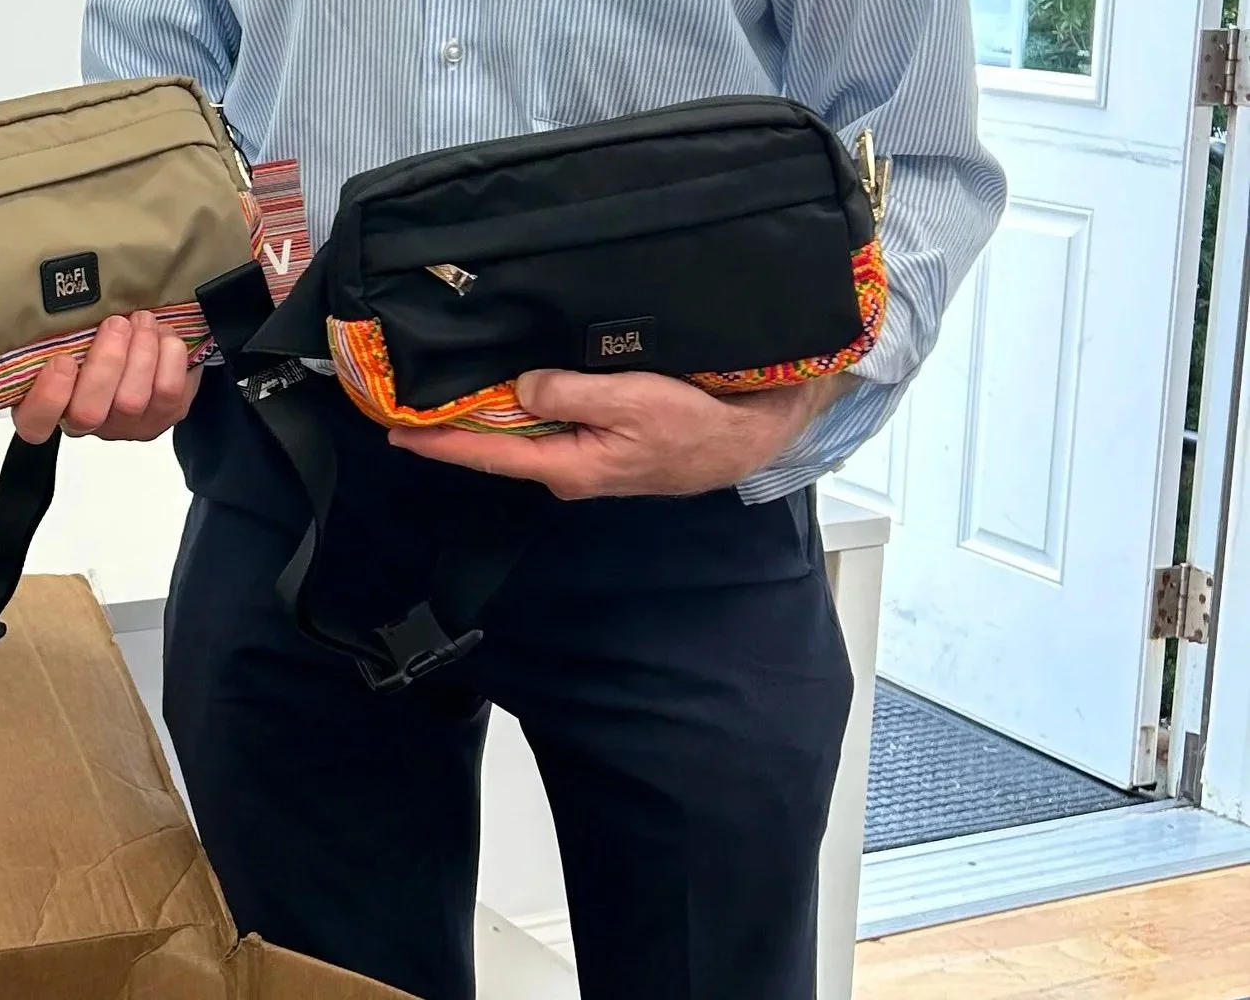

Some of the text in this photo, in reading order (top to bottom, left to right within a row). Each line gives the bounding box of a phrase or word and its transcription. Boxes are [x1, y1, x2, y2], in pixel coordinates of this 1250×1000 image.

[263, 239, 293, 275] V
[55, 279, 90, 298] NOVA
[601, 341, 643, 356] NOVA
